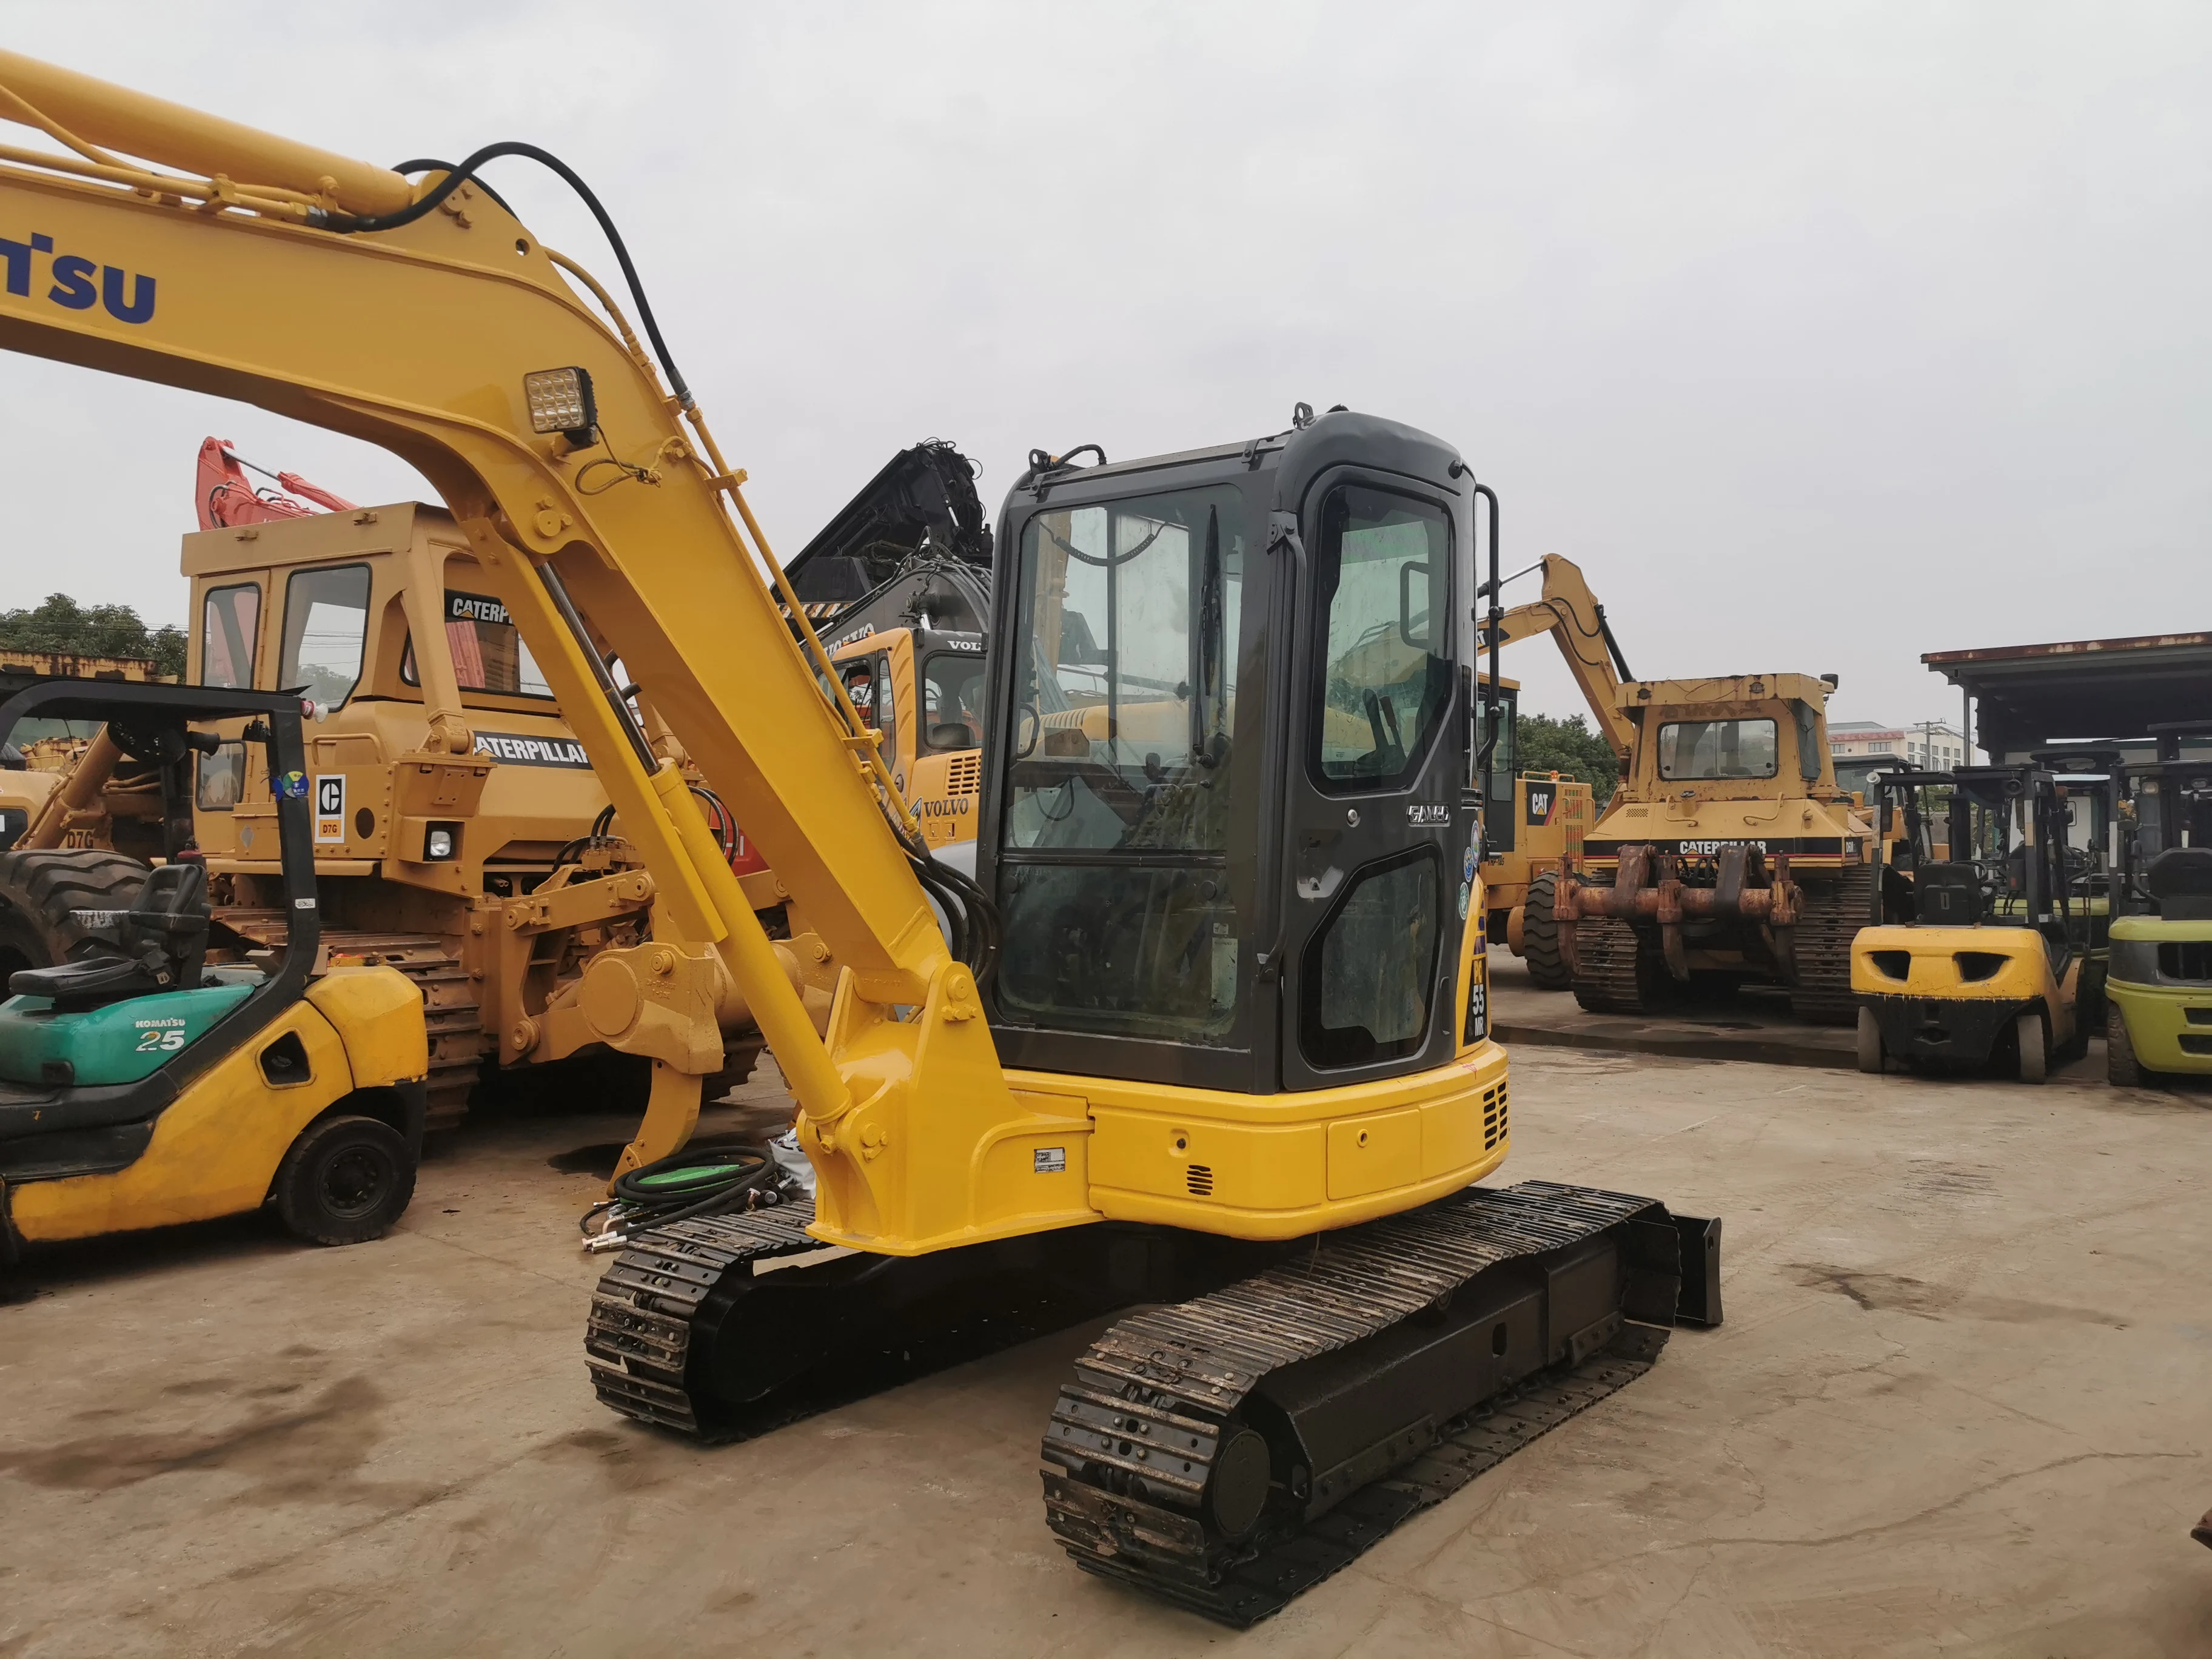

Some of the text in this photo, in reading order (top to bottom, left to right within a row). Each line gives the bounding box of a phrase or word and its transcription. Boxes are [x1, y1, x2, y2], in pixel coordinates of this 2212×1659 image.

[947, 640, 982, 651] VOL
[473, 731, 589, 763] ATERPILLA
[923, 797, 969, 817] VOLVO
[1532, 793, 1549, 815] CAT
[323, 824, 338, 834] D7G
[67, 830, 94, 849] D7G
[1472, 984, 1484, 1016] 55
[135, 1017, 186, 1028] KOMATSU
[1474, 1016, 1484, 1037] MR
[135, 1030, 186, 1052] 25
